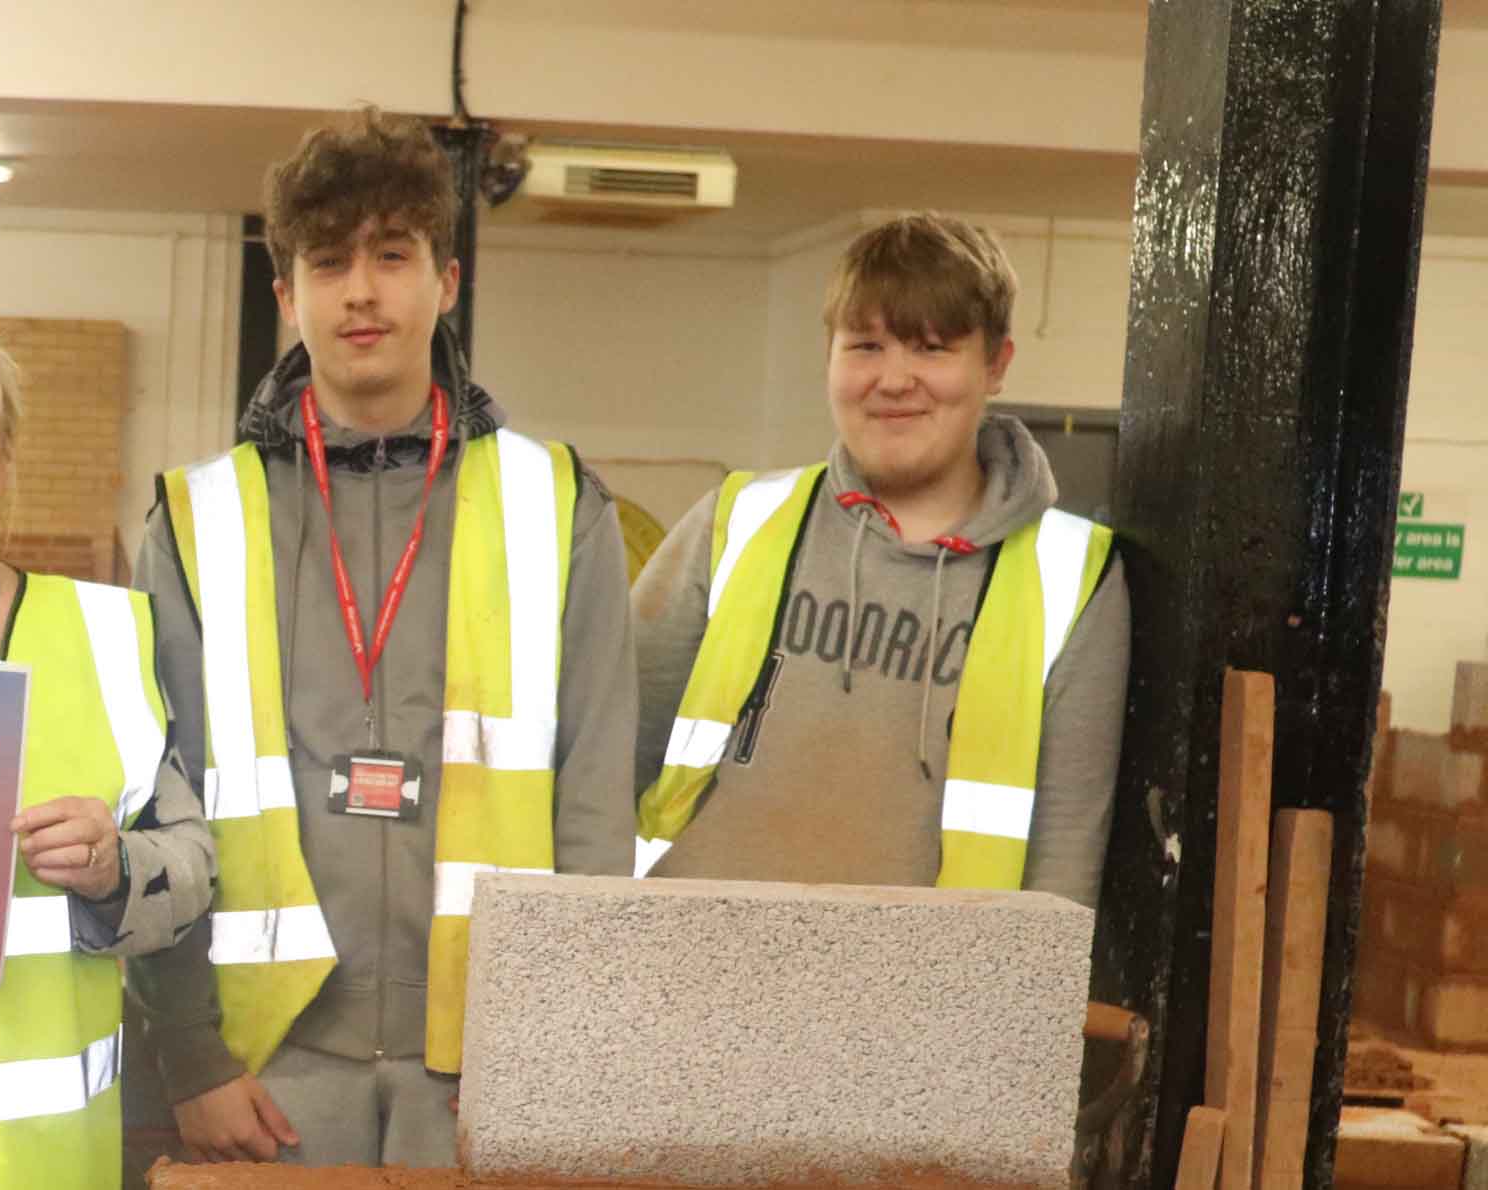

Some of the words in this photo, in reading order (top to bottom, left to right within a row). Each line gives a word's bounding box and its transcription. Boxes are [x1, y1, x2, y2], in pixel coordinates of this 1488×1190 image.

[1406, 532, 1442, 547] area
[1445, 530, 1460, 549] is
[1416, 556, 1453, 572] area
